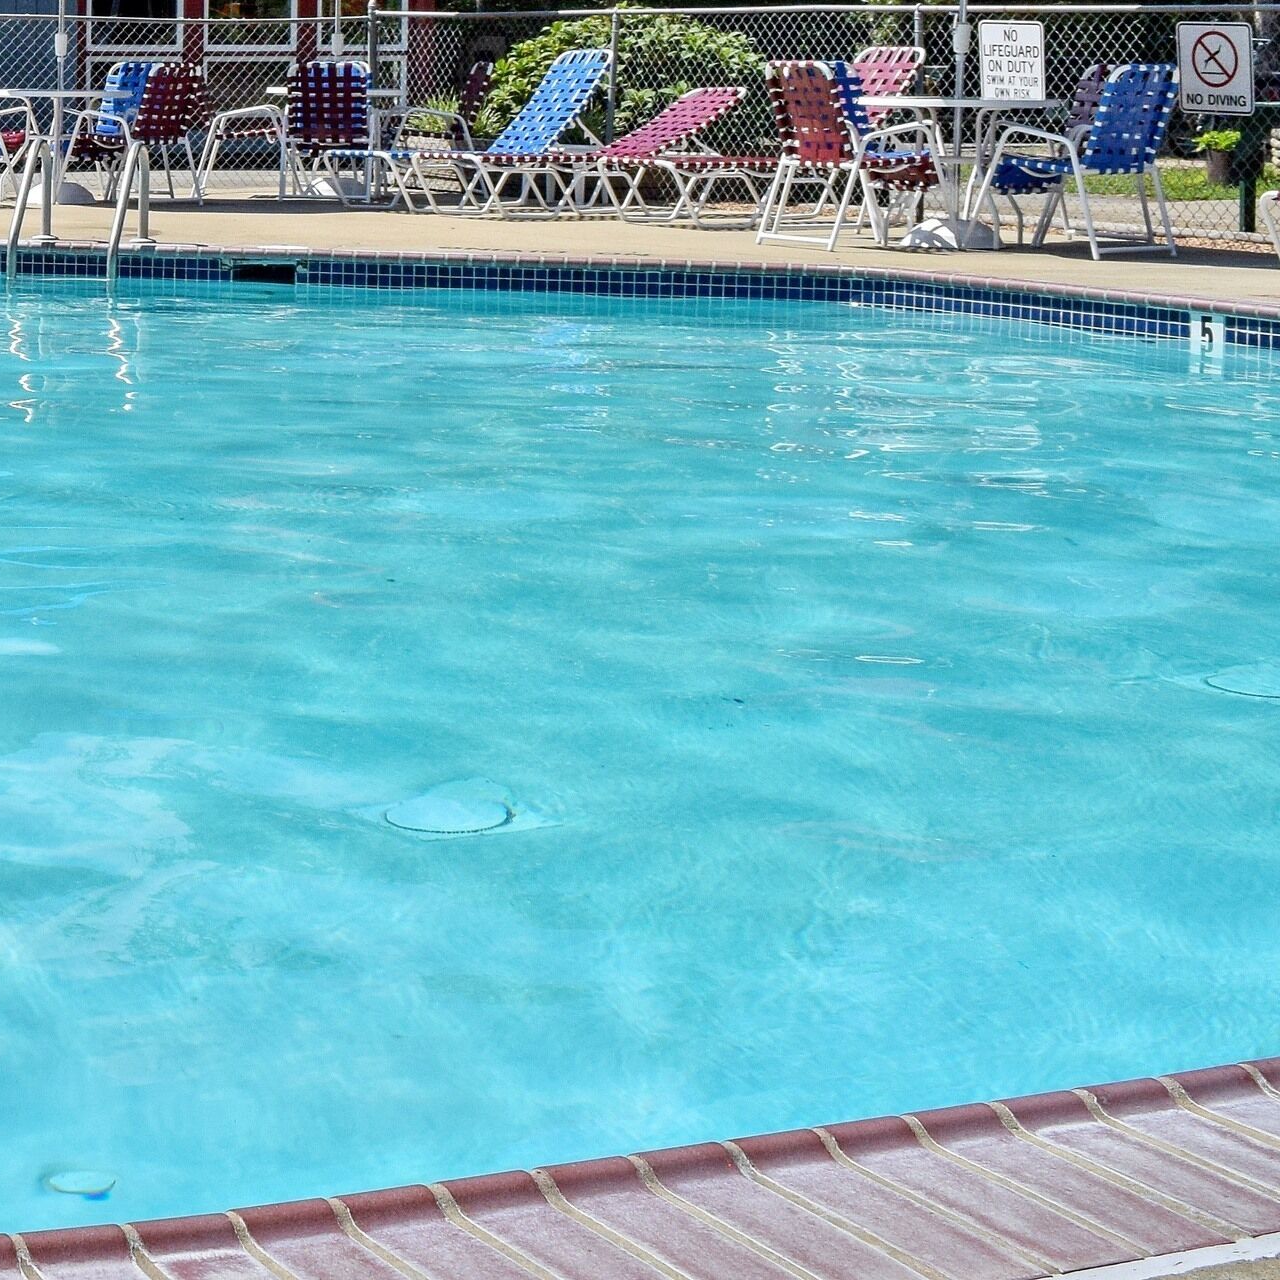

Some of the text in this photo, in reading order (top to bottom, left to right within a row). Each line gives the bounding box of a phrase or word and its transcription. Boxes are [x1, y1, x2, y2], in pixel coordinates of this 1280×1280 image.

[1003, 29, 1018, 42] NO
[983, 44, 1040, 58] LIFEGUARD
[988, 59, 1035, 73] ON DUTY
[986, 75, 1039, 87] SWIM AT YOUR
[994, 88, 1031, 99] OWN RISK
[1186, 93, 1247, 107] NO DIVING
[1201, 316, 1214, 343] 5
